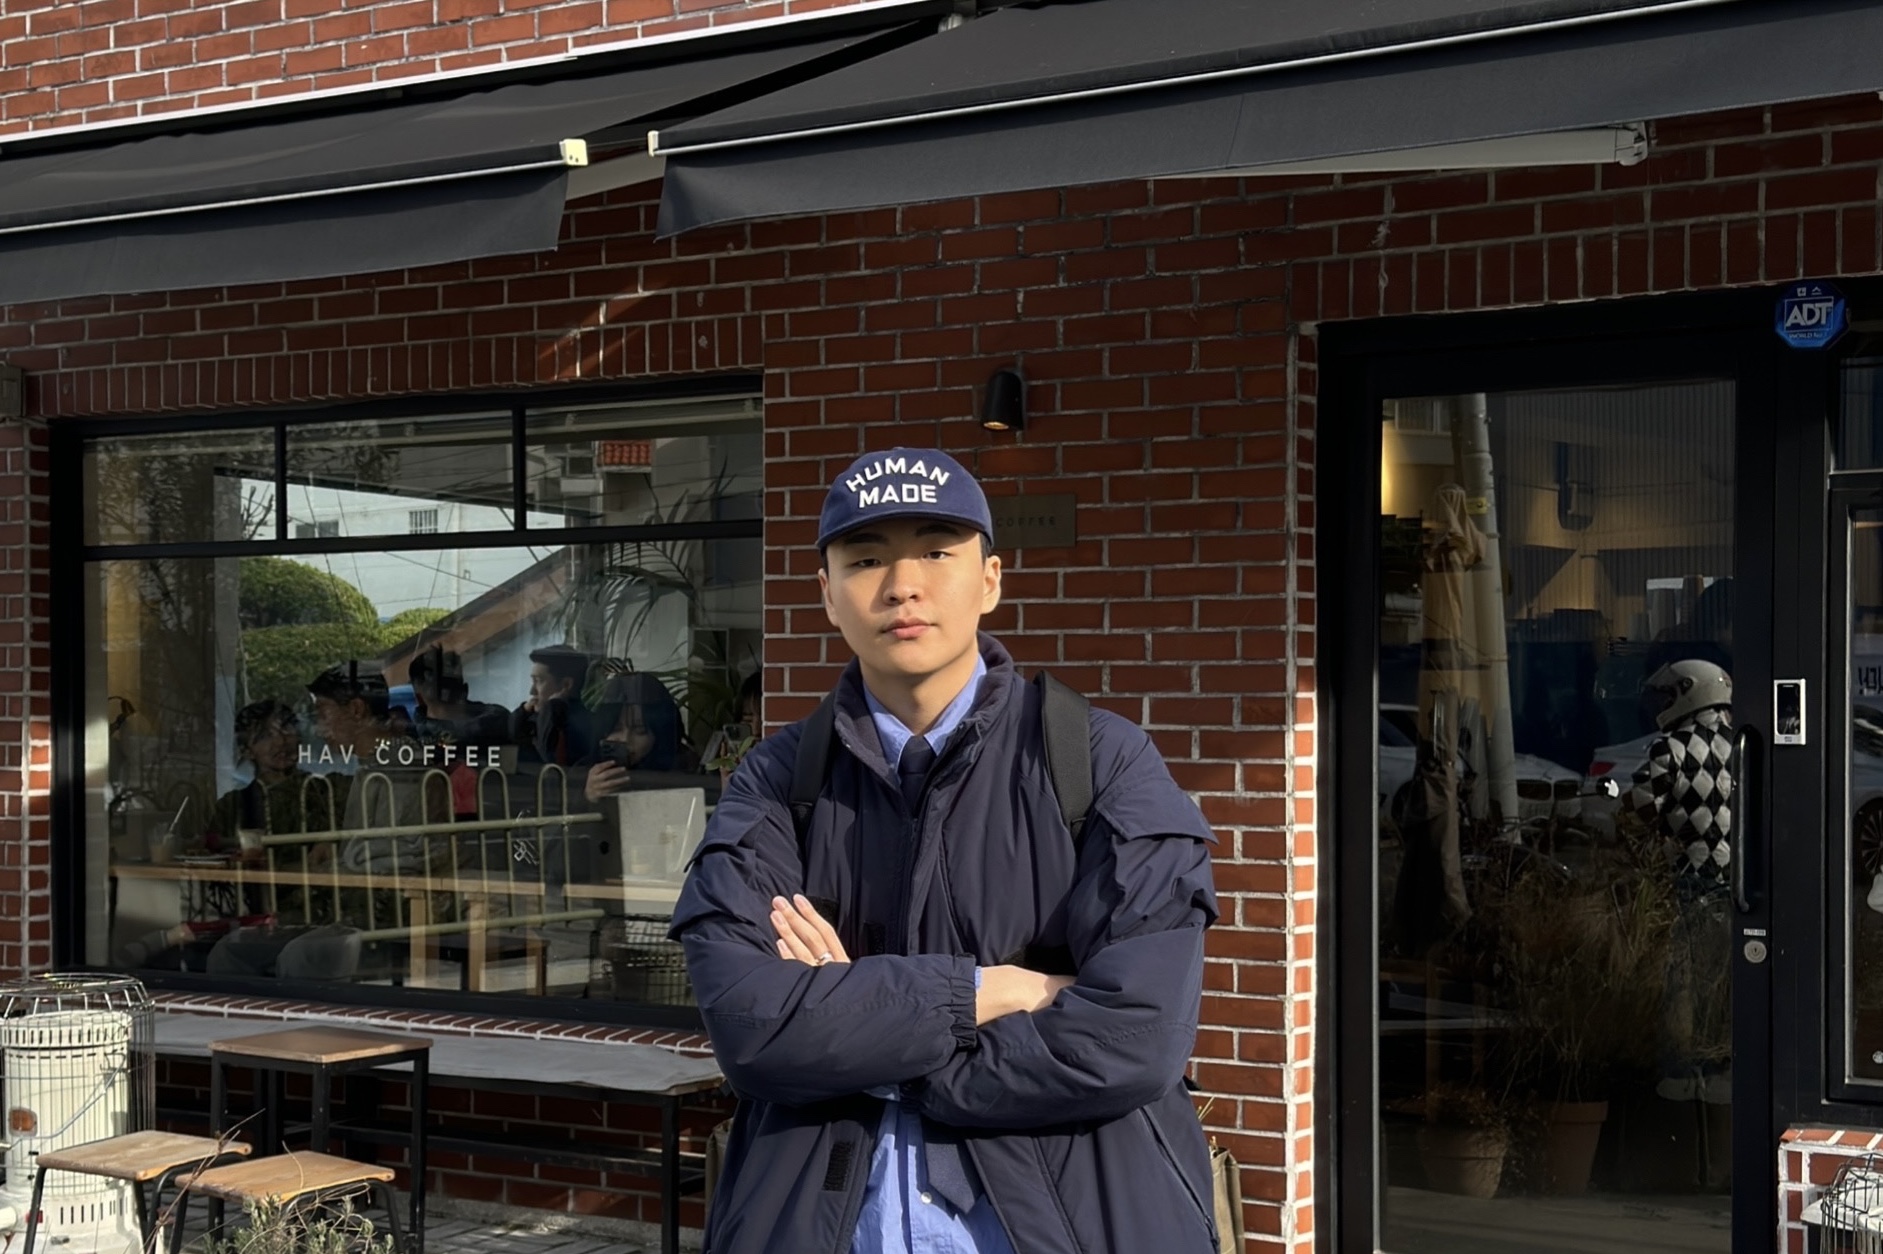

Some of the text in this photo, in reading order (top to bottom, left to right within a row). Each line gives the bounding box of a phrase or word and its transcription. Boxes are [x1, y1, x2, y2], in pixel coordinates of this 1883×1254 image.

[1785, 302, 1834, 327] ADT
[846, 457, 950, 492] HUMAN
[859, 483, 938, 508] MADE
[996, 515, 1056, 527] COFFEE
[298, 744, 501, 767] HAV COFFEE
